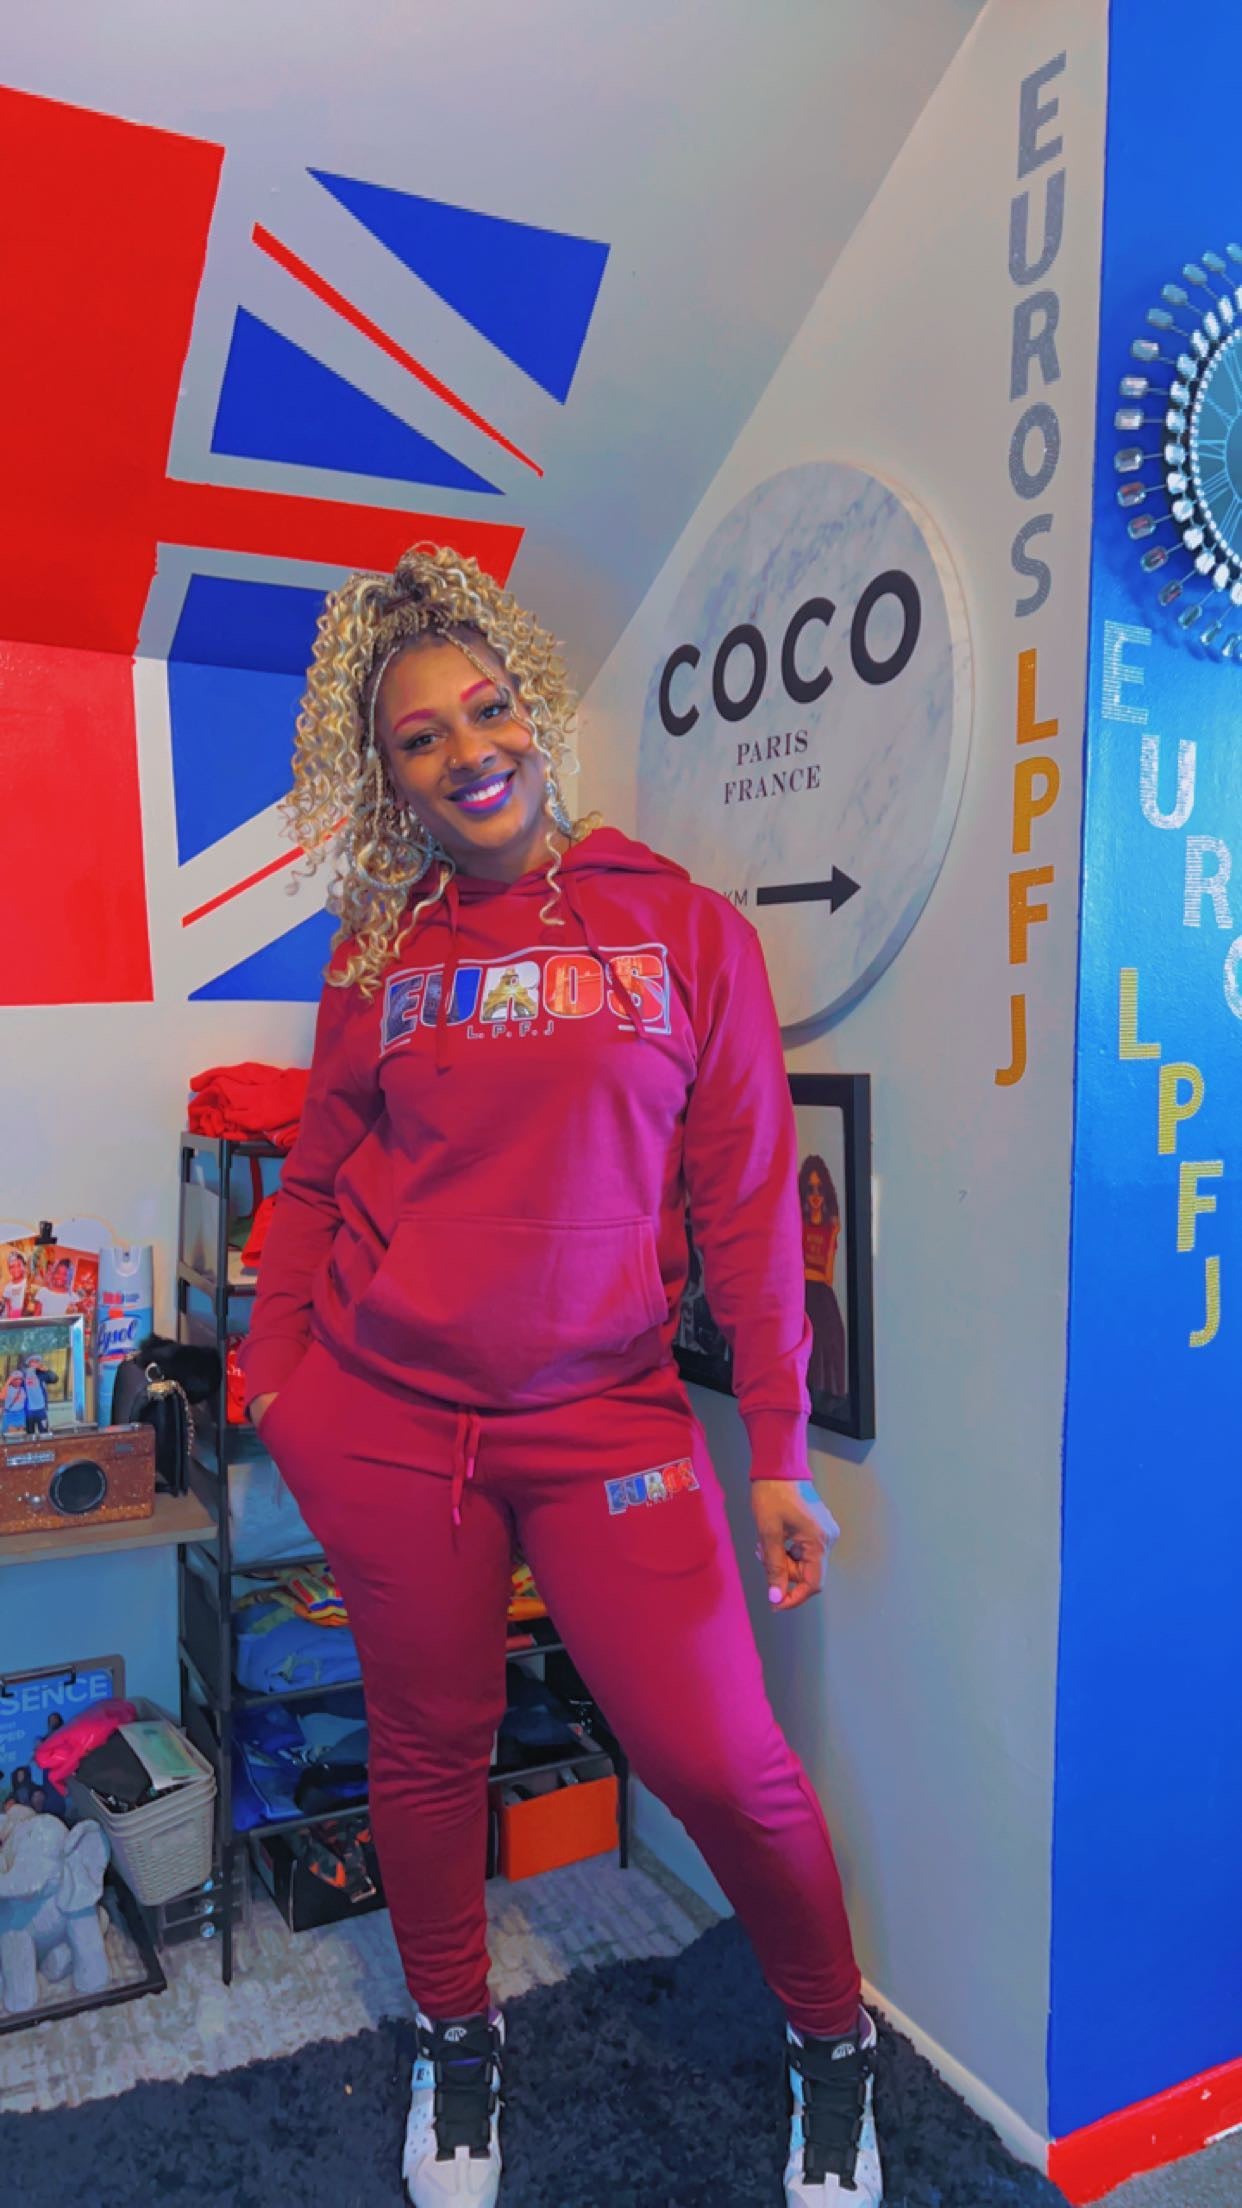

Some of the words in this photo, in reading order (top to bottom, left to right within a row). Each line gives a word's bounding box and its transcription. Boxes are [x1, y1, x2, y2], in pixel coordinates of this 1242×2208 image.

[1008, 50, 1066, 617] EUROS
[659, 569, 921, 736] COCO
[724, 765, 821, 804] FRANCE
[736, 729, 809, 766] PARIS
[384, 955, 665, 1046] EUROS
